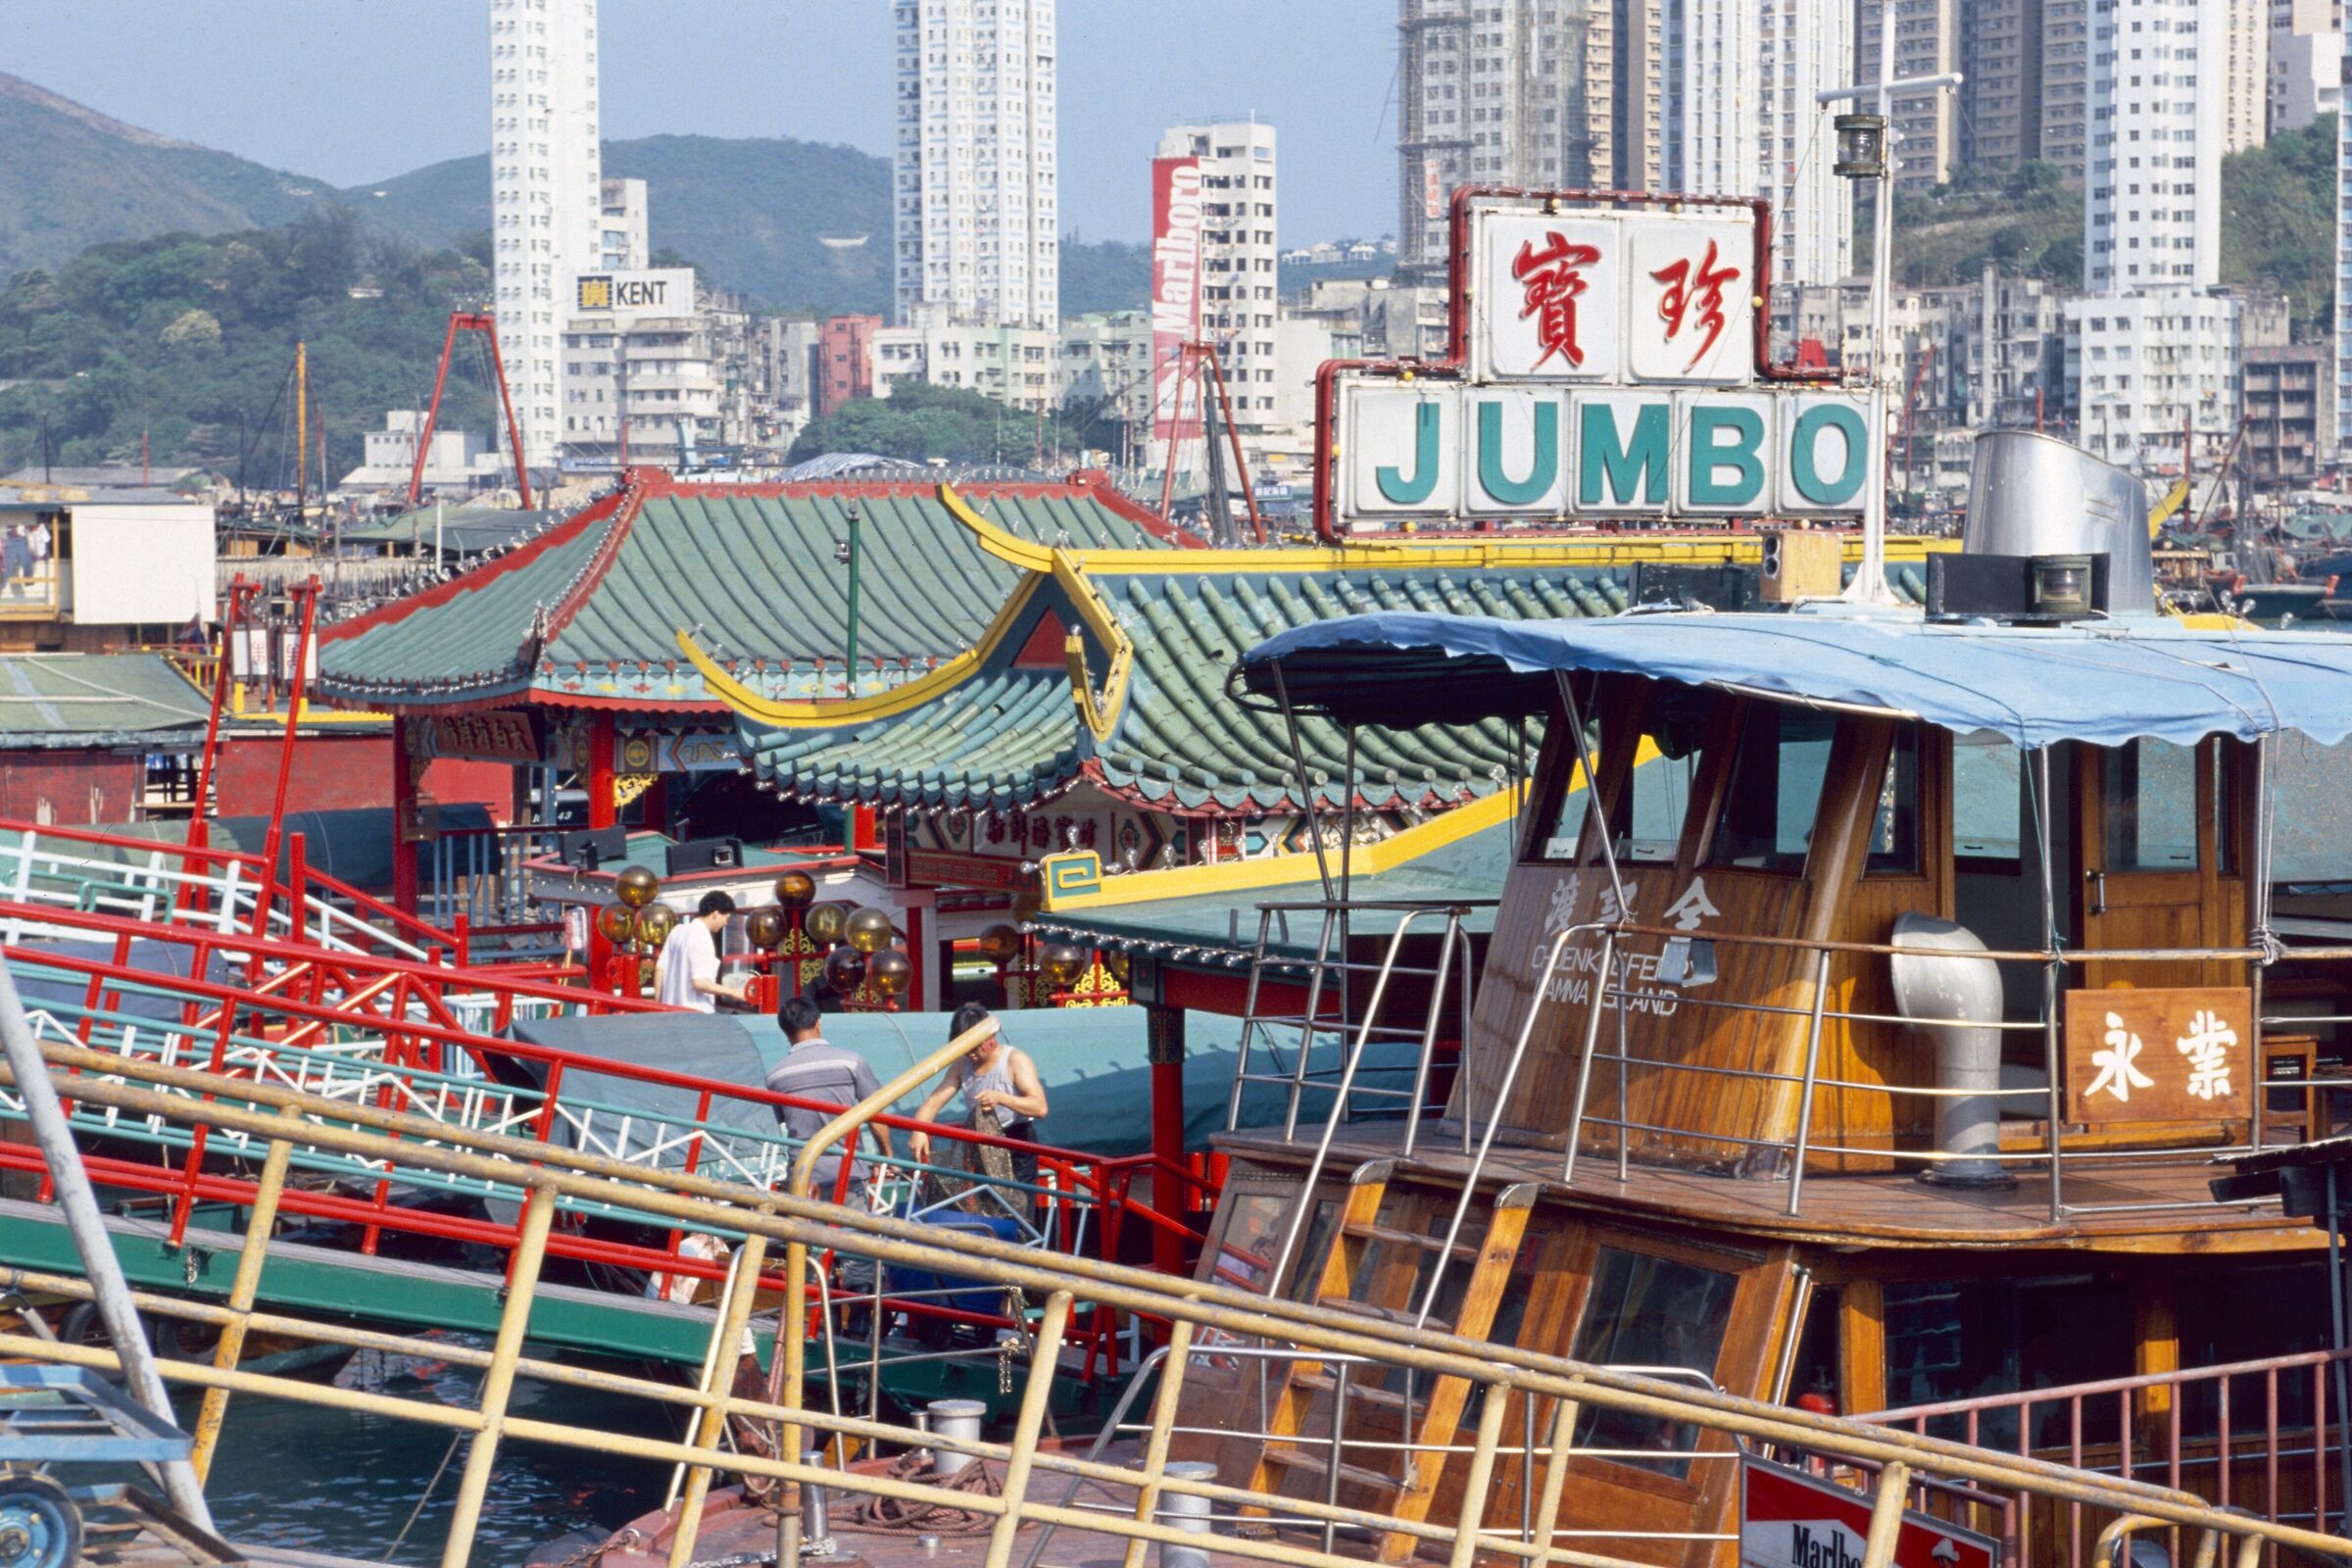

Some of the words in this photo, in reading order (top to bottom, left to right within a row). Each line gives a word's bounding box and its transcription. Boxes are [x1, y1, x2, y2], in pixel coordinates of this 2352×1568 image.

[616, 280, 667, 306] KENT
[1152, 165, 1201, 335] Marlboro
[1375, 400, 1870, 506] JUMBO
